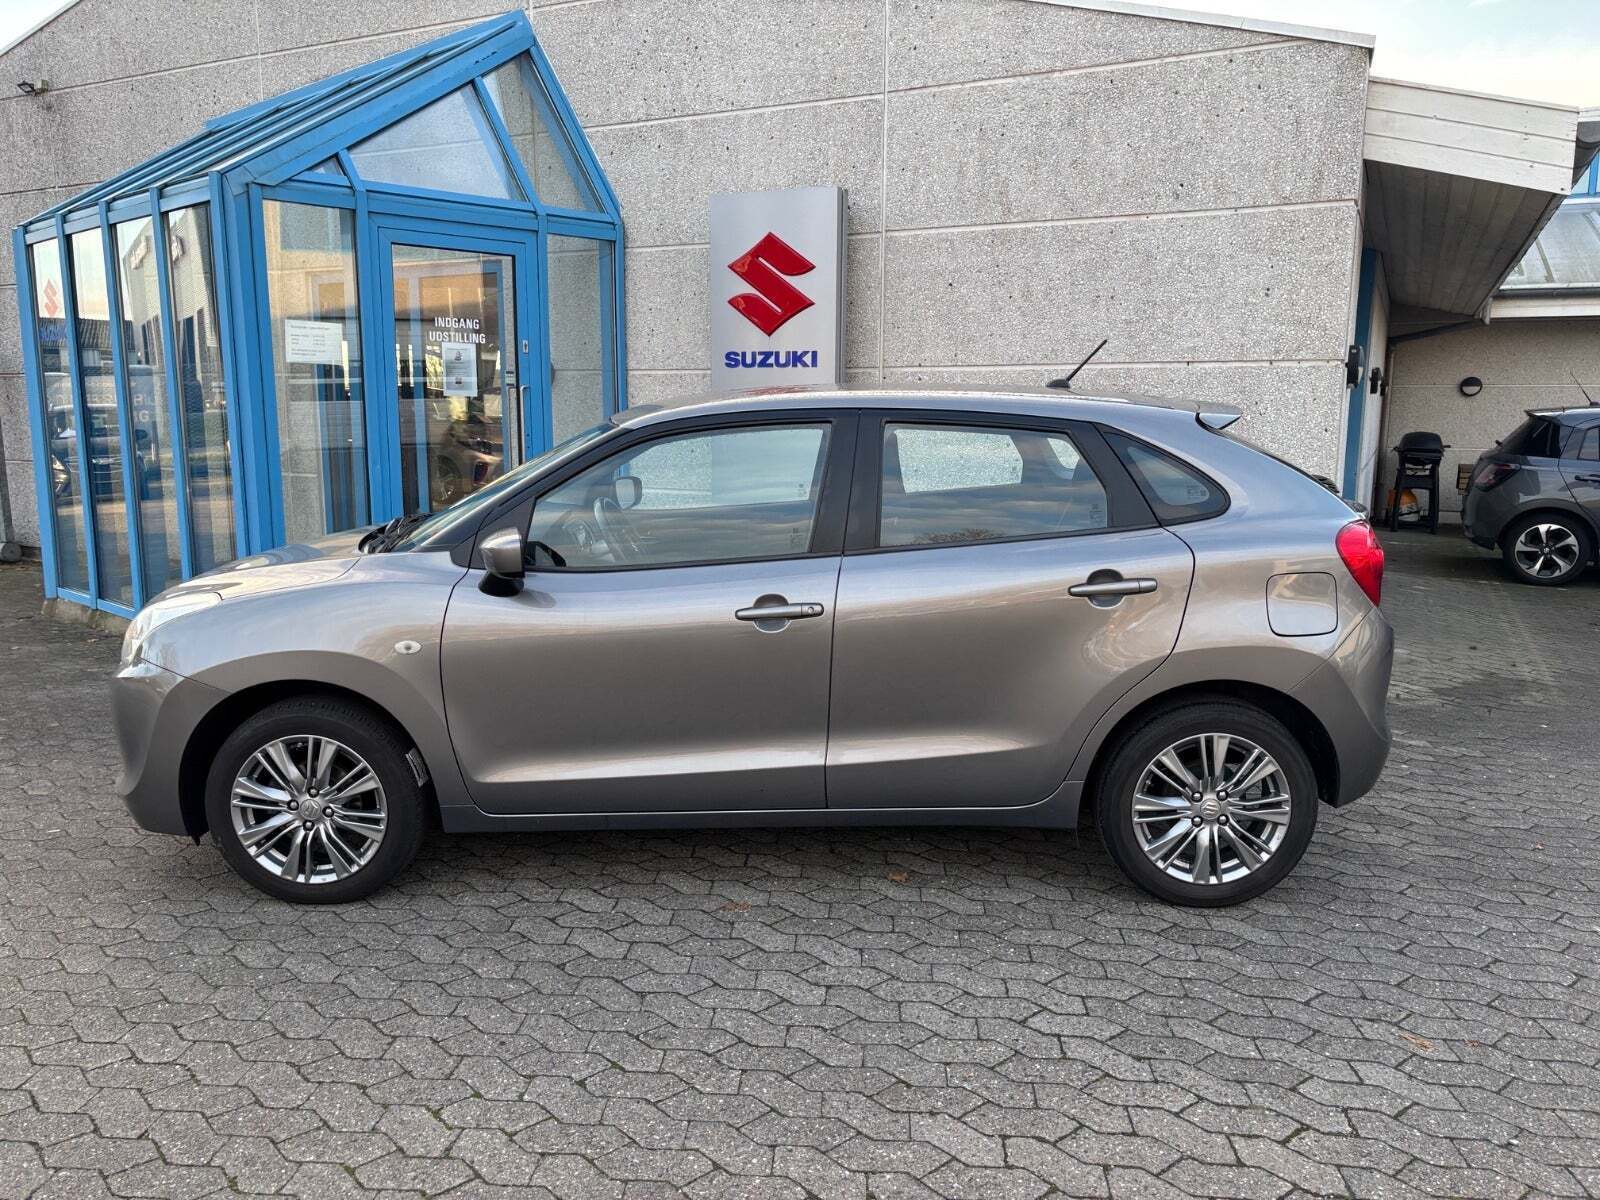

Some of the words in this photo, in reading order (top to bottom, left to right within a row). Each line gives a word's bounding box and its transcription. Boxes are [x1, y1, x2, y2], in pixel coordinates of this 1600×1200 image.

[434, 317, 480, 330] INDGANG
[429, 331, 486, 344] UDSTILLING
[724, 350, 818, 368] SUZUKI
